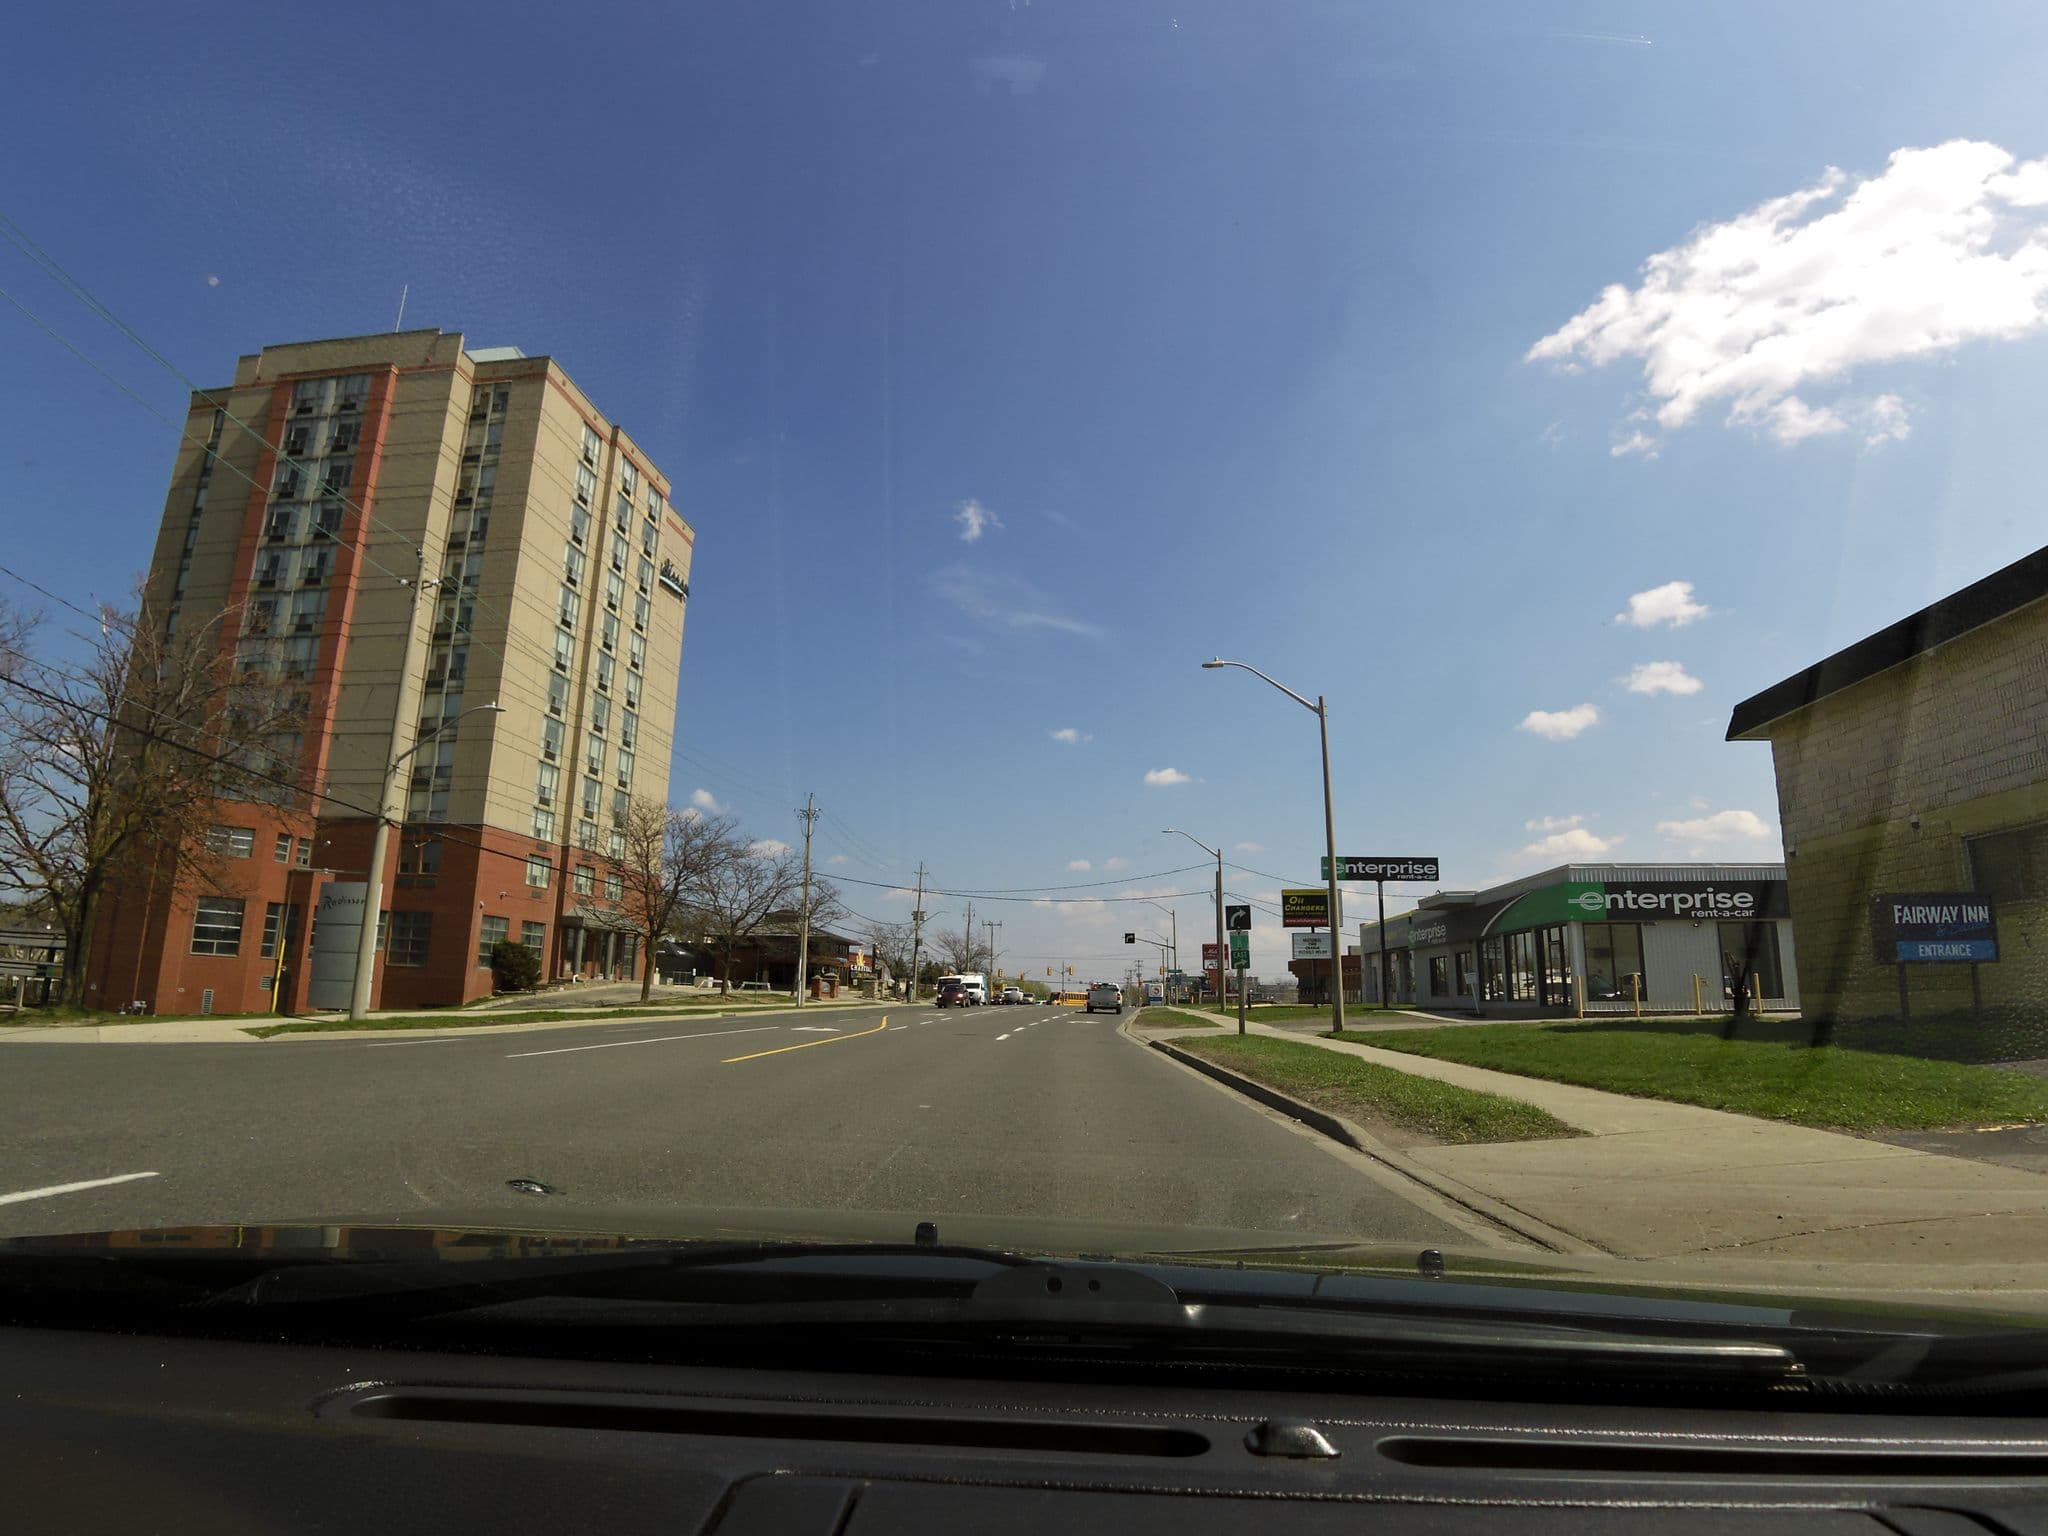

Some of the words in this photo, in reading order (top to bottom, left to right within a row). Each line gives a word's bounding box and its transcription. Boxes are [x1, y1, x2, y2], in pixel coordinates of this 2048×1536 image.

[1335, 861, 1438, 878] enterprise
[1575, 887, 1755, 915] enterprise
[1691, 908, 1756, 918] rent-a-car
[1893, 904, 1959, 924] FAIRWAY
[1962, 904, 1990, 924] INN
[1919, 944, 1973, 957] ENTRANCE
